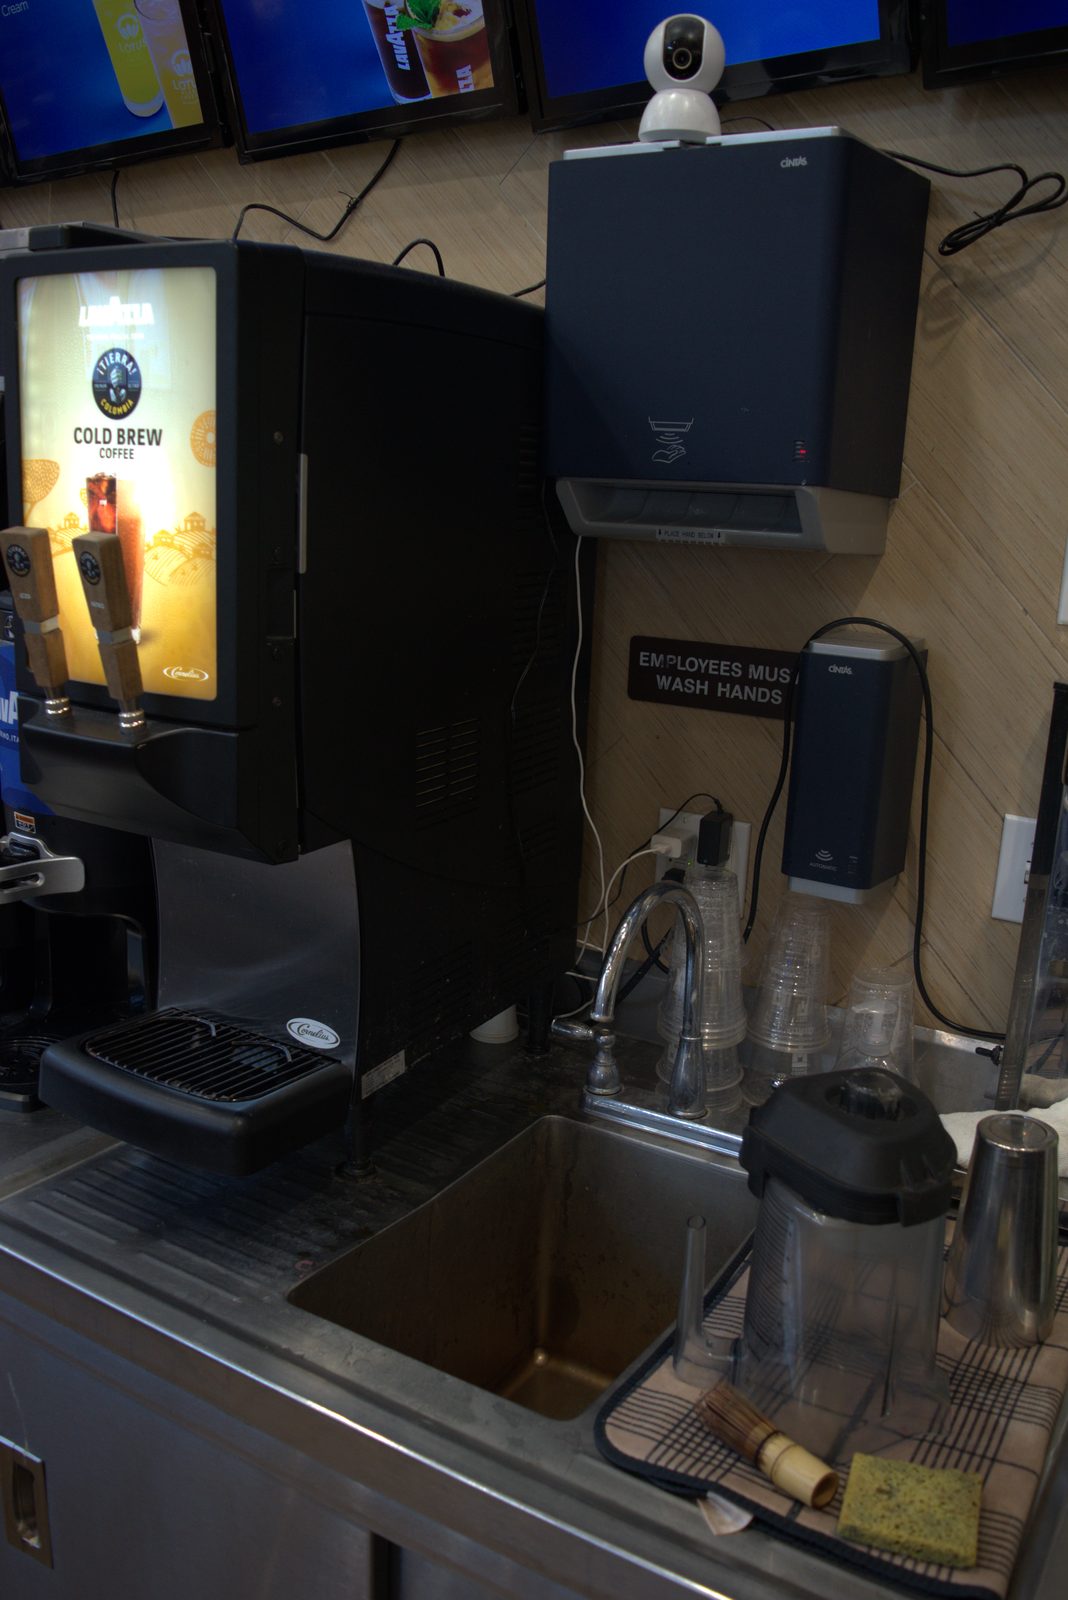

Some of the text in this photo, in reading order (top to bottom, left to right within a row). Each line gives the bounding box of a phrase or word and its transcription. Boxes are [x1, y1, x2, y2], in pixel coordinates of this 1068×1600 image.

[1, 1, 30, 16] Cream
[100, 398, 134, 415] COLOMBIA
[74, 427, 163, 446] COLD BREW
[99, 448, 134, 459] COFFEE
[639, 651, 800, 685] EMPLOYEES MUS
[656, 674, 783, 705] WASH HANDS
[809, 862, 838, 872] AUTOMATIC
[297, 1023, 330, 1042] Cornelius
